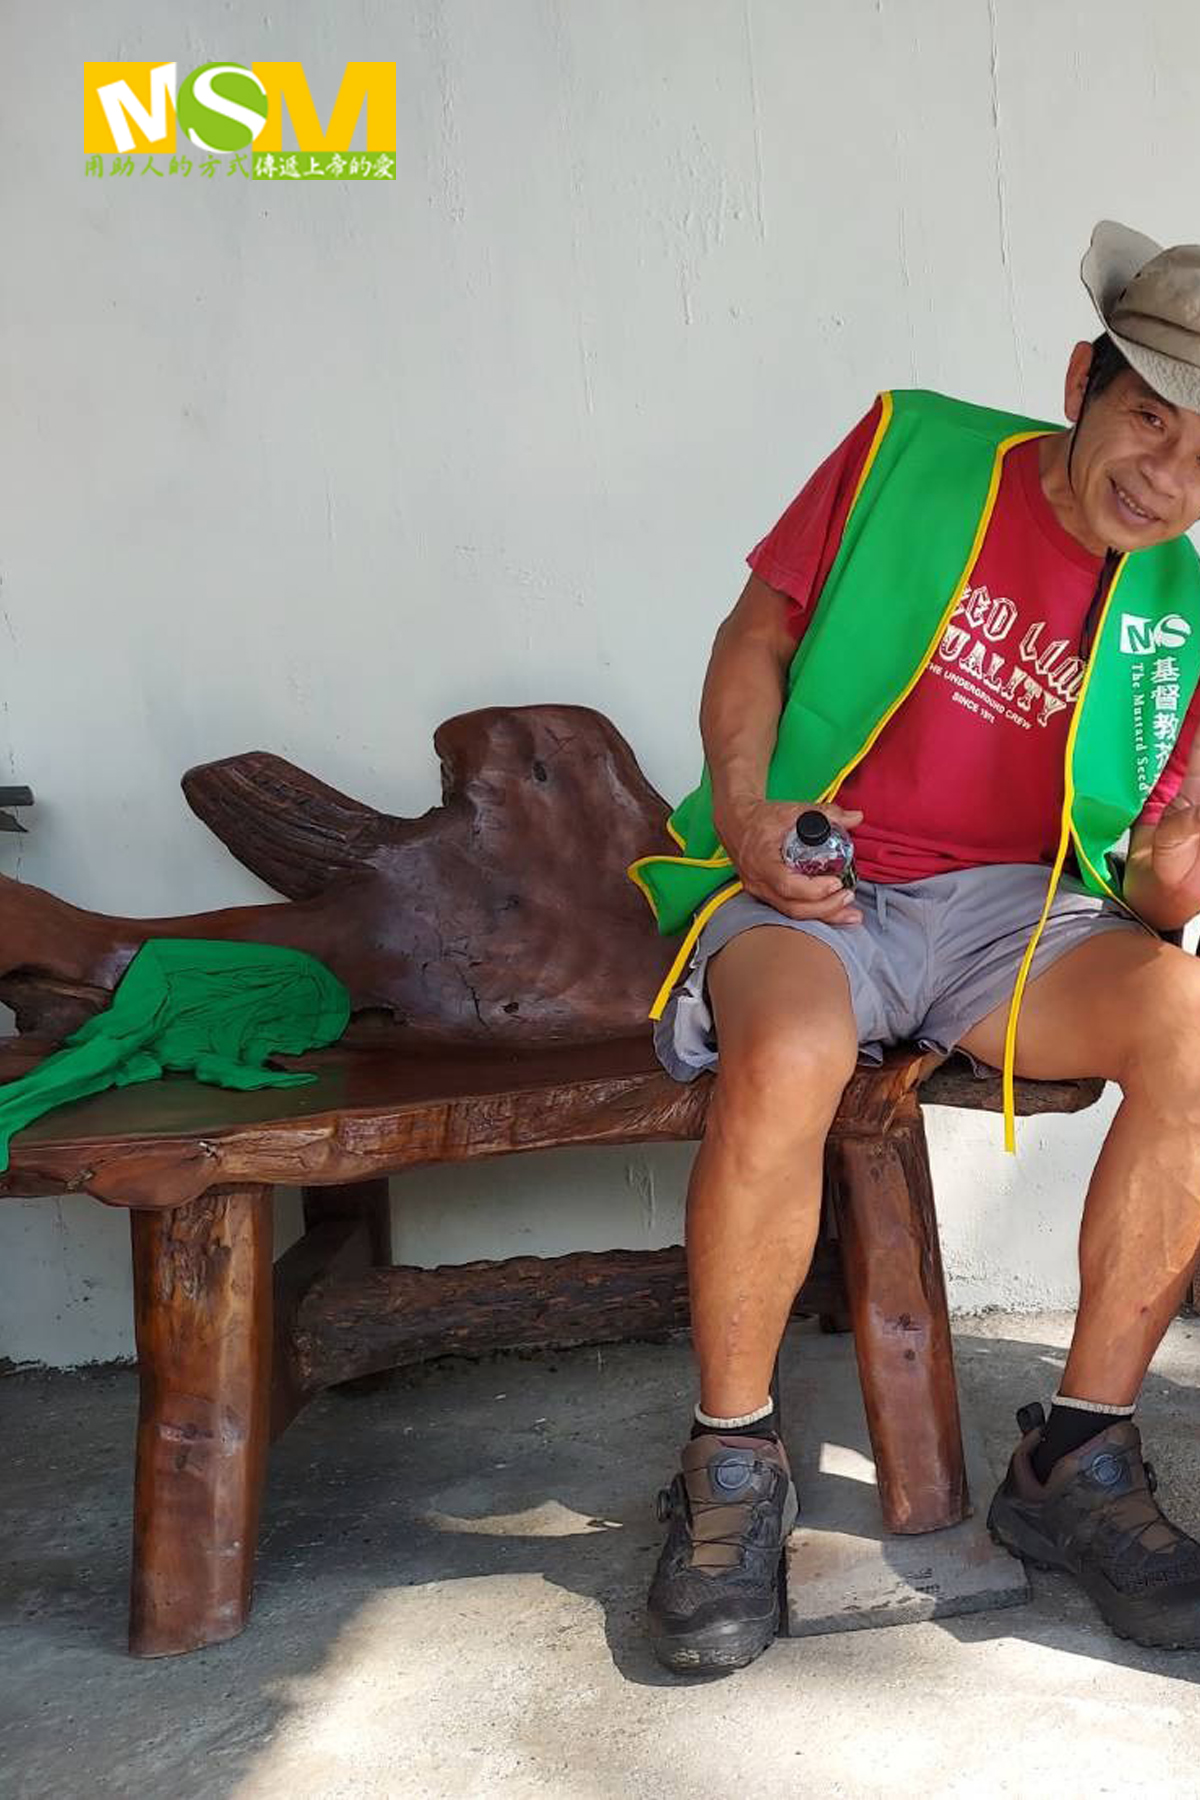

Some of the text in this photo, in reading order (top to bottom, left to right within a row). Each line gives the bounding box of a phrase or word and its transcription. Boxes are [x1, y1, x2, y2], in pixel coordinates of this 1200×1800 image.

[943, 670, 1005, 714] UNDERGROUND
[1005, 709, 1032, 730] CREW
[951, 692, 980, 713] SINCE
[1131, 662, 1150, 791] The Mustard Seed
